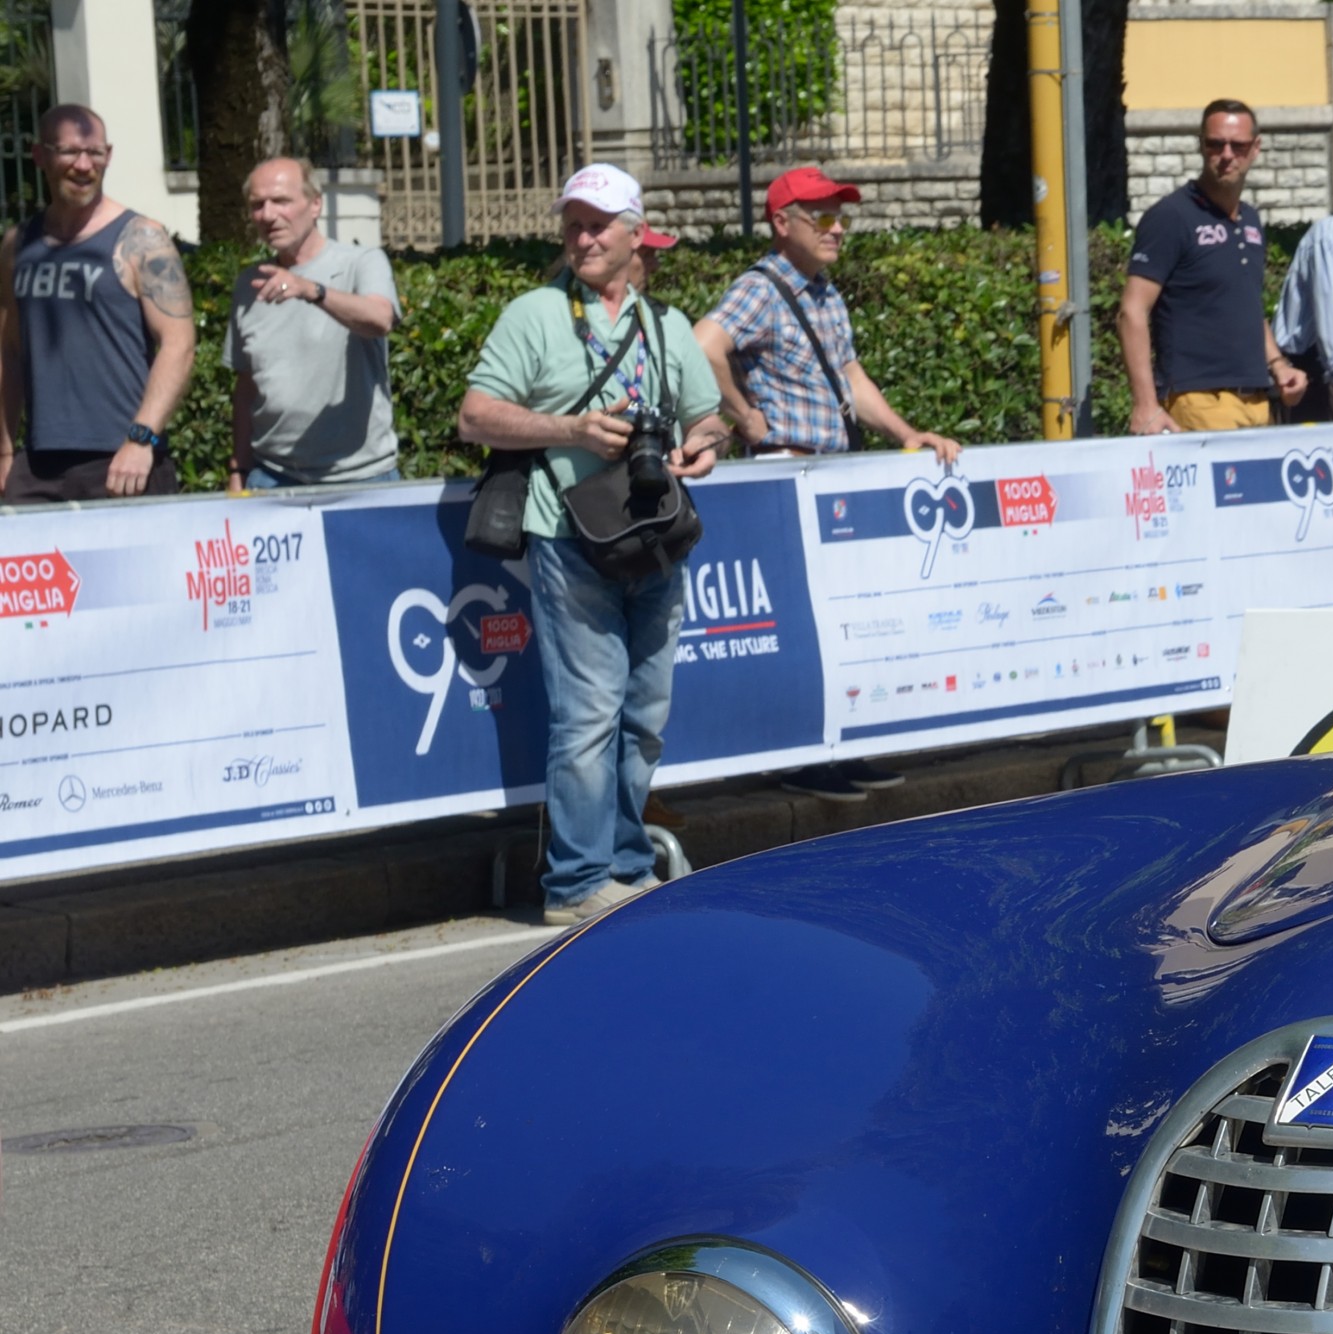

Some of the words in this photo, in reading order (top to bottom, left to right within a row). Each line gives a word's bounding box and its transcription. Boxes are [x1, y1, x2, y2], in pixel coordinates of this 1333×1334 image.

[1166, 463, 1198, 488] 2017
[1003, 480, 1042, 499] 1000
[1005, 503, 1049, 523] MIGLIA
[195, 518, 250, 569] Mille
[253, 532, 304, 563] 2017
[186, 565, 251, 631] Miglia
[486, 619, 519, 633] 1000
[485, 635, 521, 649] MIGLIA
[700, 639, 728, 660] THE
[729, 634, 779, 658] FUTURE
[91, 780, 163, 801] Mercedes-Benz
